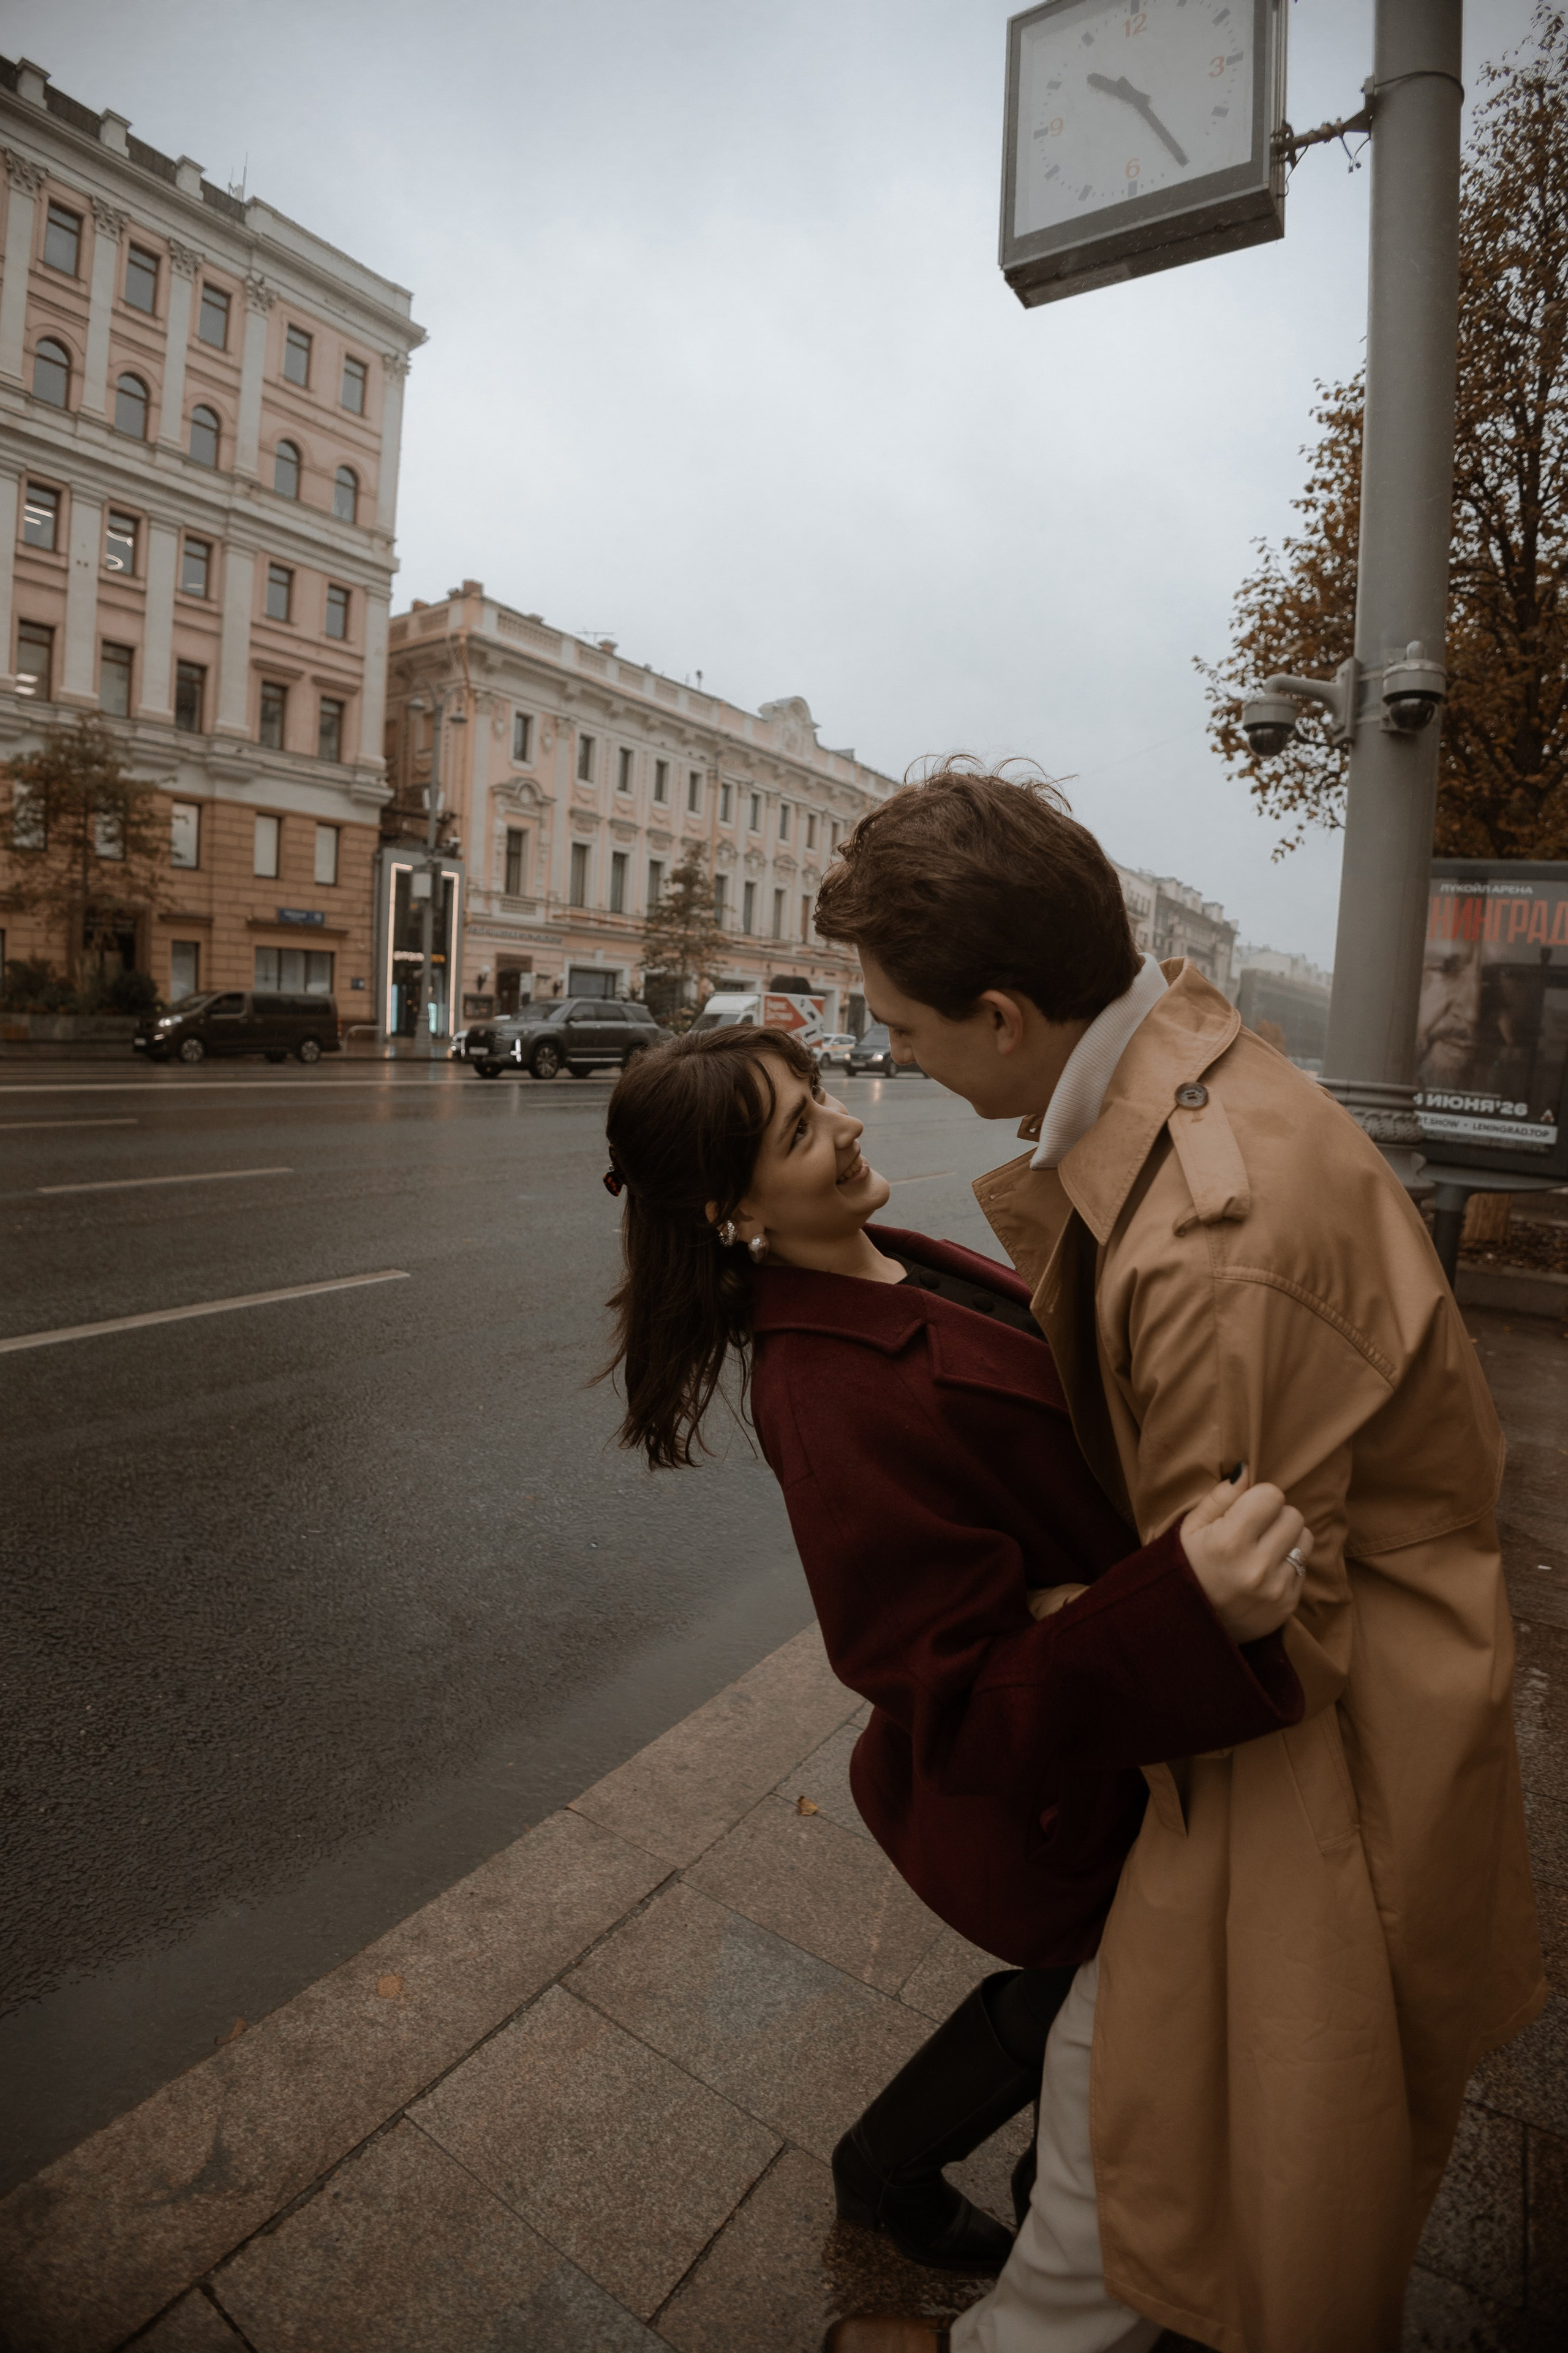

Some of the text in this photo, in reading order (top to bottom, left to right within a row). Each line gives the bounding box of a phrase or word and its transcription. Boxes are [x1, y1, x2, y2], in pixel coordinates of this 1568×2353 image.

[1123, 12, 1147, 38] 12
[1208, 56, 1225, 78] 3
[1049, 117, 1064, 137] 9
[1125, 158, 1140, 178] 6
[1441, 882, 1533, 895] ЛУКОЙЛ АРЕНА
[1428, 897, 1568, 945] НИНГРАД
